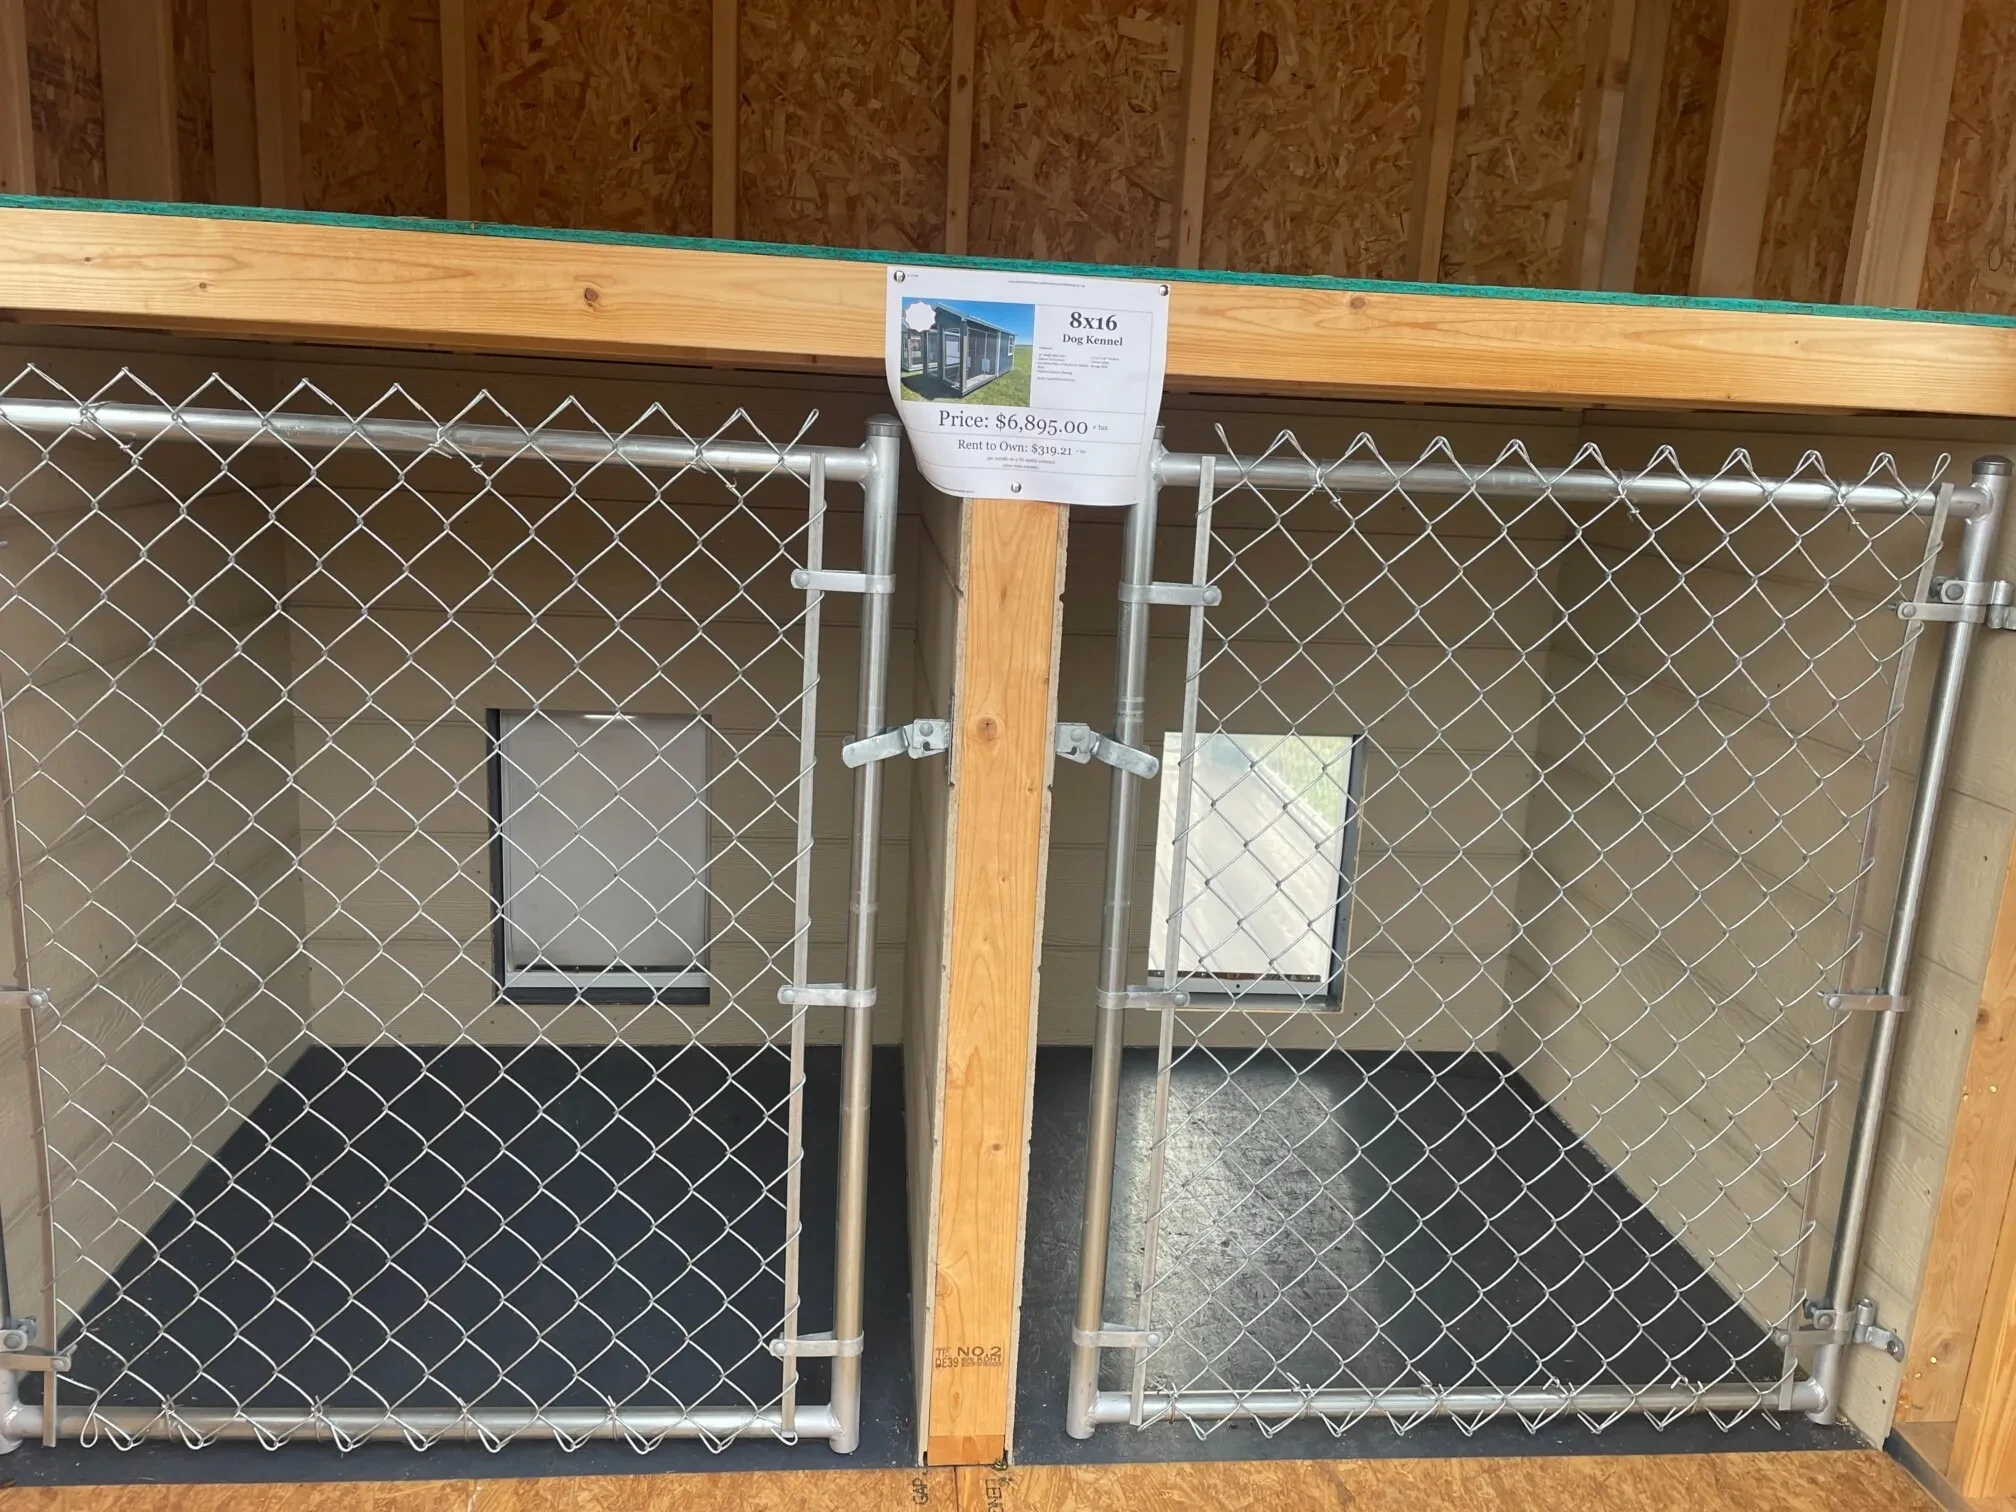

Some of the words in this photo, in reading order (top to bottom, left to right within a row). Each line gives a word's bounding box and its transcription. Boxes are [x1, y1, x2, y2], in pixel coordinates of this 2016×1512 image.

[1069, 311, 1118, 332] 8x16
[1062, 333, 1084, 346] Dog
[1085, 335, 1123, 347] Kennel
[938, 409, 989, 428] Price:
[995, 412, 1088, 436] $6,895.00
[957, 439, 983, 450] Rent
[986, 442, 997, 451] to
[999, 441, 1029, 453] Own:
[1031, 443, 1072, 457] $319.21
[957, 1346, 1002, 1357] NO.2
